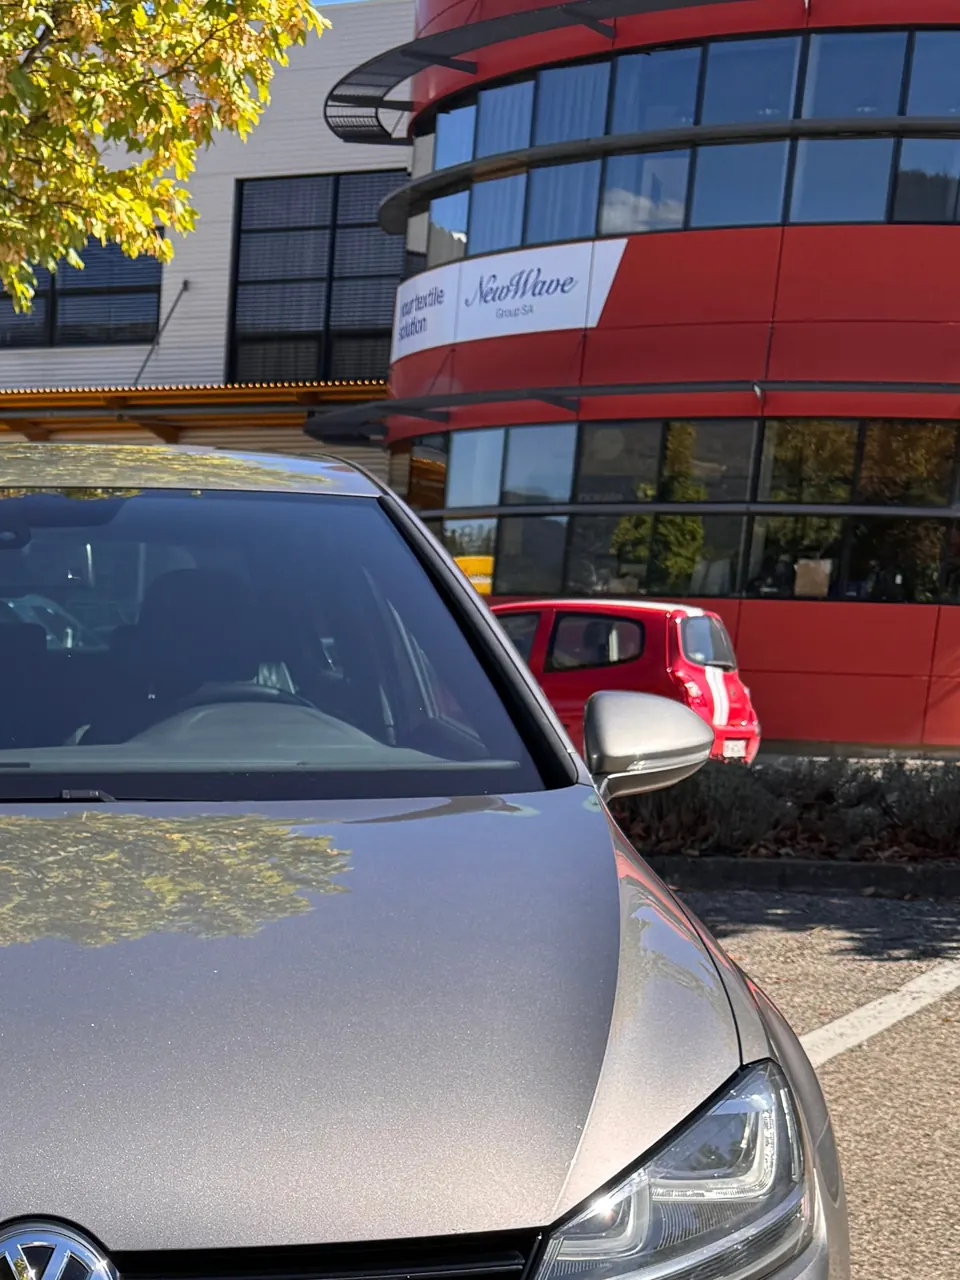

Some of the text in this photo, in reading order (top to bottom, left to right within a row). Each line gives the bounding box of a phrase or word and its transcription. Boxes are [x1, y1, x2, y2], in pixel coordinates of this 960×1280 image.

[415, 286, 445, 312] textile
[495, 304, 534, 319] Group SA
[398, 316, 427, 342] solution
